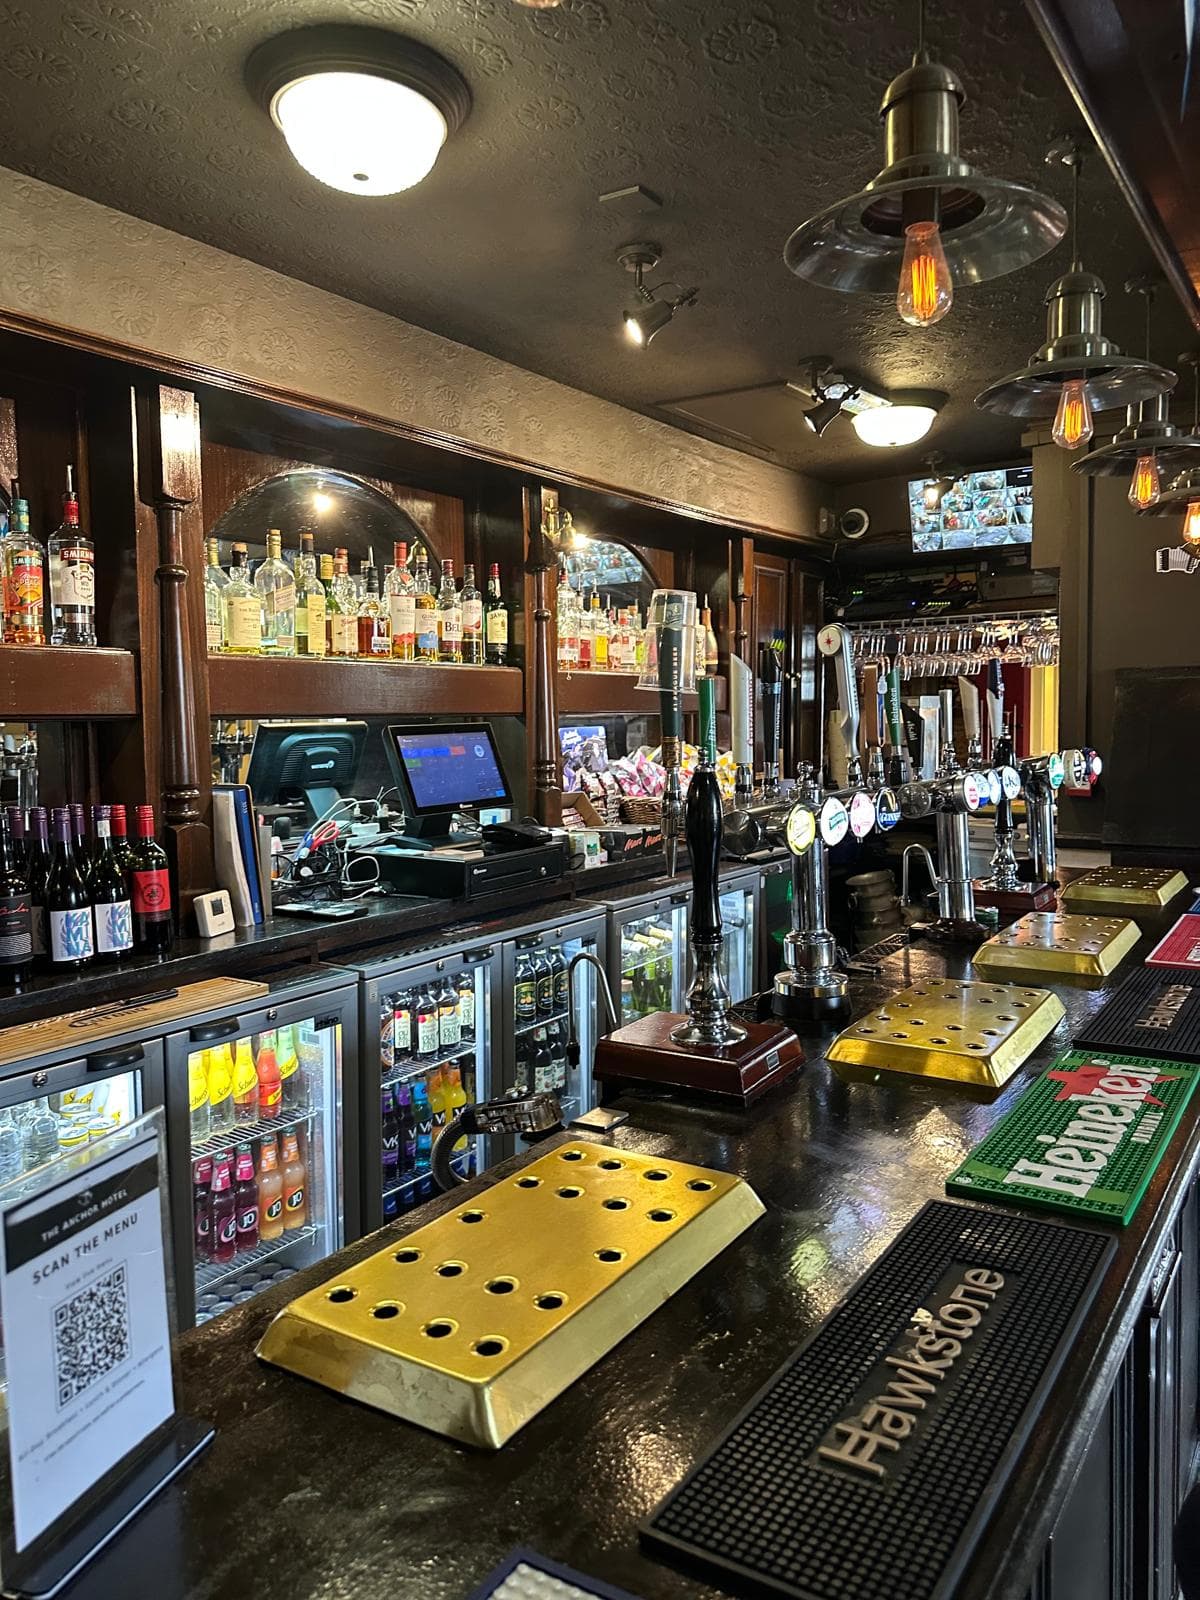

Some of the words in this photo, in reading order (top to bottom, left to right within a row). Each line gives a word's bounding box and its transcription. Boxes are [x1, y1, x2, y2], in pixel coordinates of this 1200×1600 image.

[624, 837, 643, 851] Mars
[1135, 984, 1192, 1031] Hawkstone
[383, 1134, 399, 1148] VK
[1002, 1058, 1161, 1198] Heineken
[41, 1226, 59, 1243] THE
[62, 1204, 99, 1231] ANCHOR
[101, 1189, 128, 1210] HOTEL
[32, 1254, 70, 1285] SCAN
[74, 1235, 100, 1259] THE
[103, 1213, 138, 1241] MENU
[818, 1268, 1005, 1477] Hawkstone
